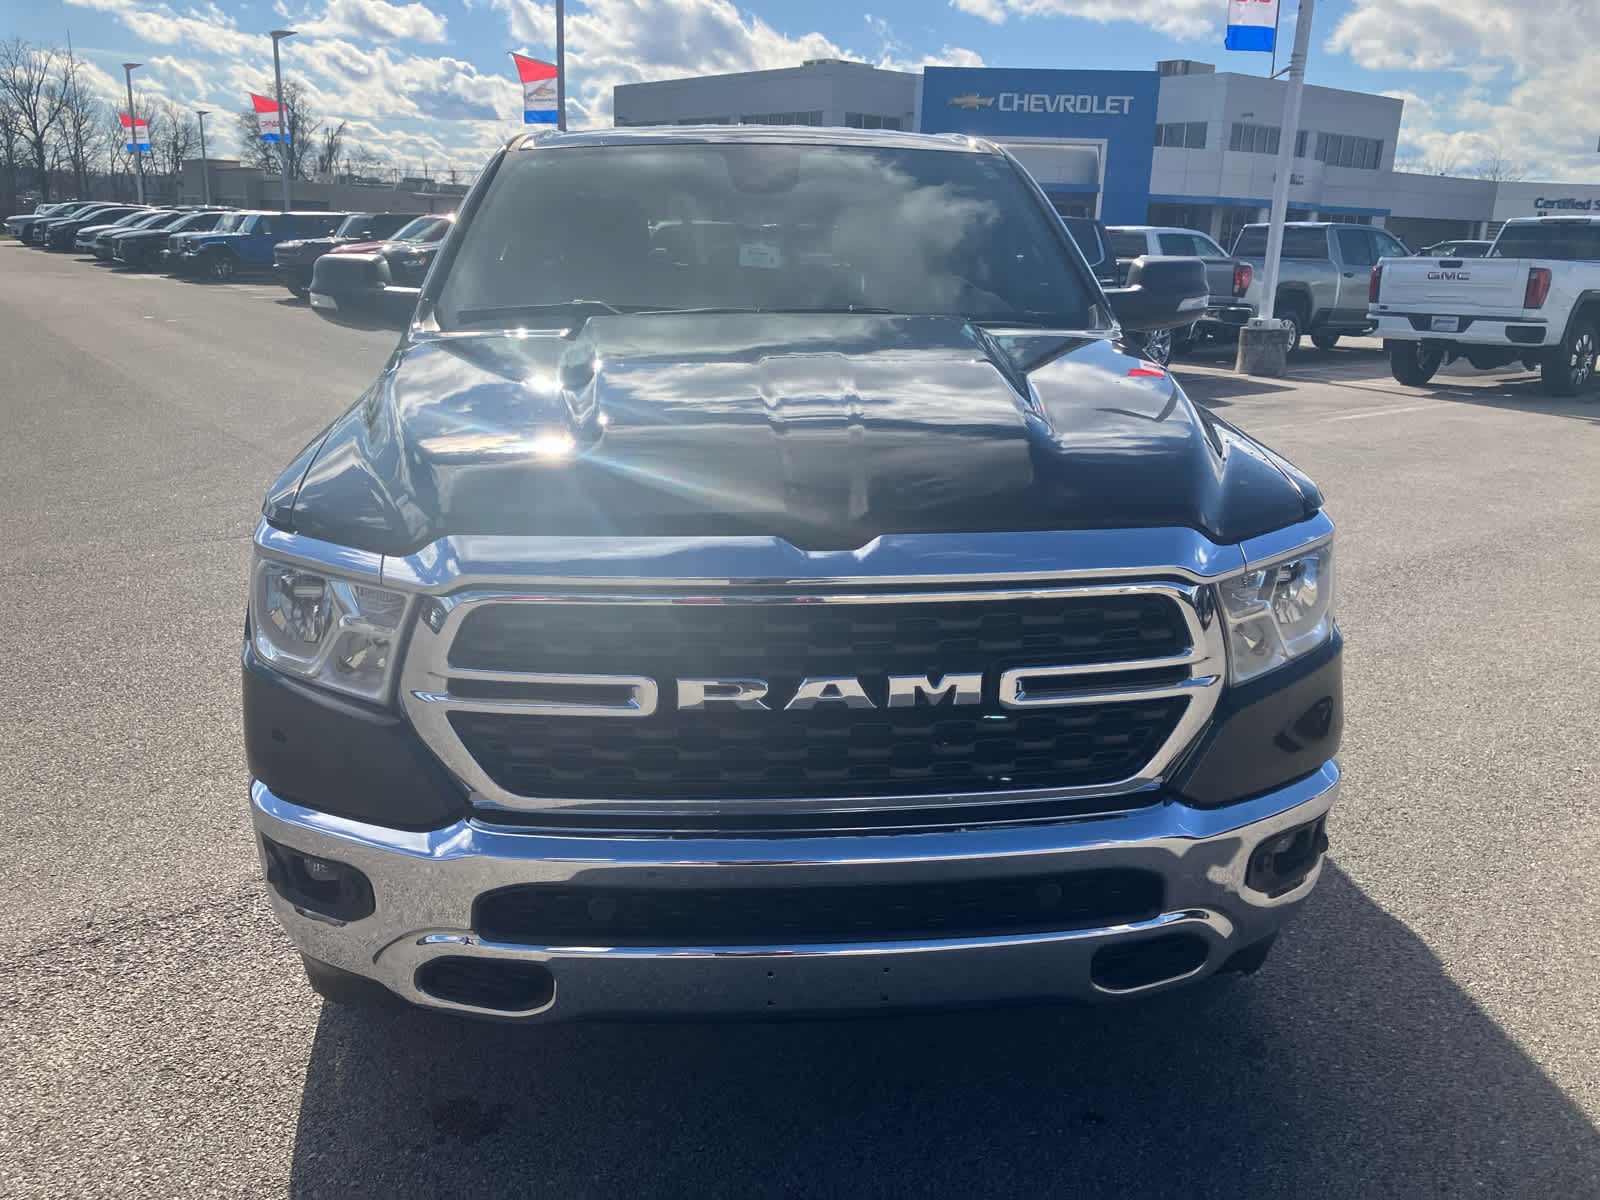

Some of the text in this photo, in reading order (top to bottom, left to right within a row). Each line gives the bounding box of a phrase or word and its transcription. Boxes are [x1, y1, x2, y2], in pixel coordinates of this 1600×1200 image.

[999, 92, 1135, 115] CHEVROLET
[1427, 271, 1471, 281] GMC
[676, 672, 984, 710] RAM
